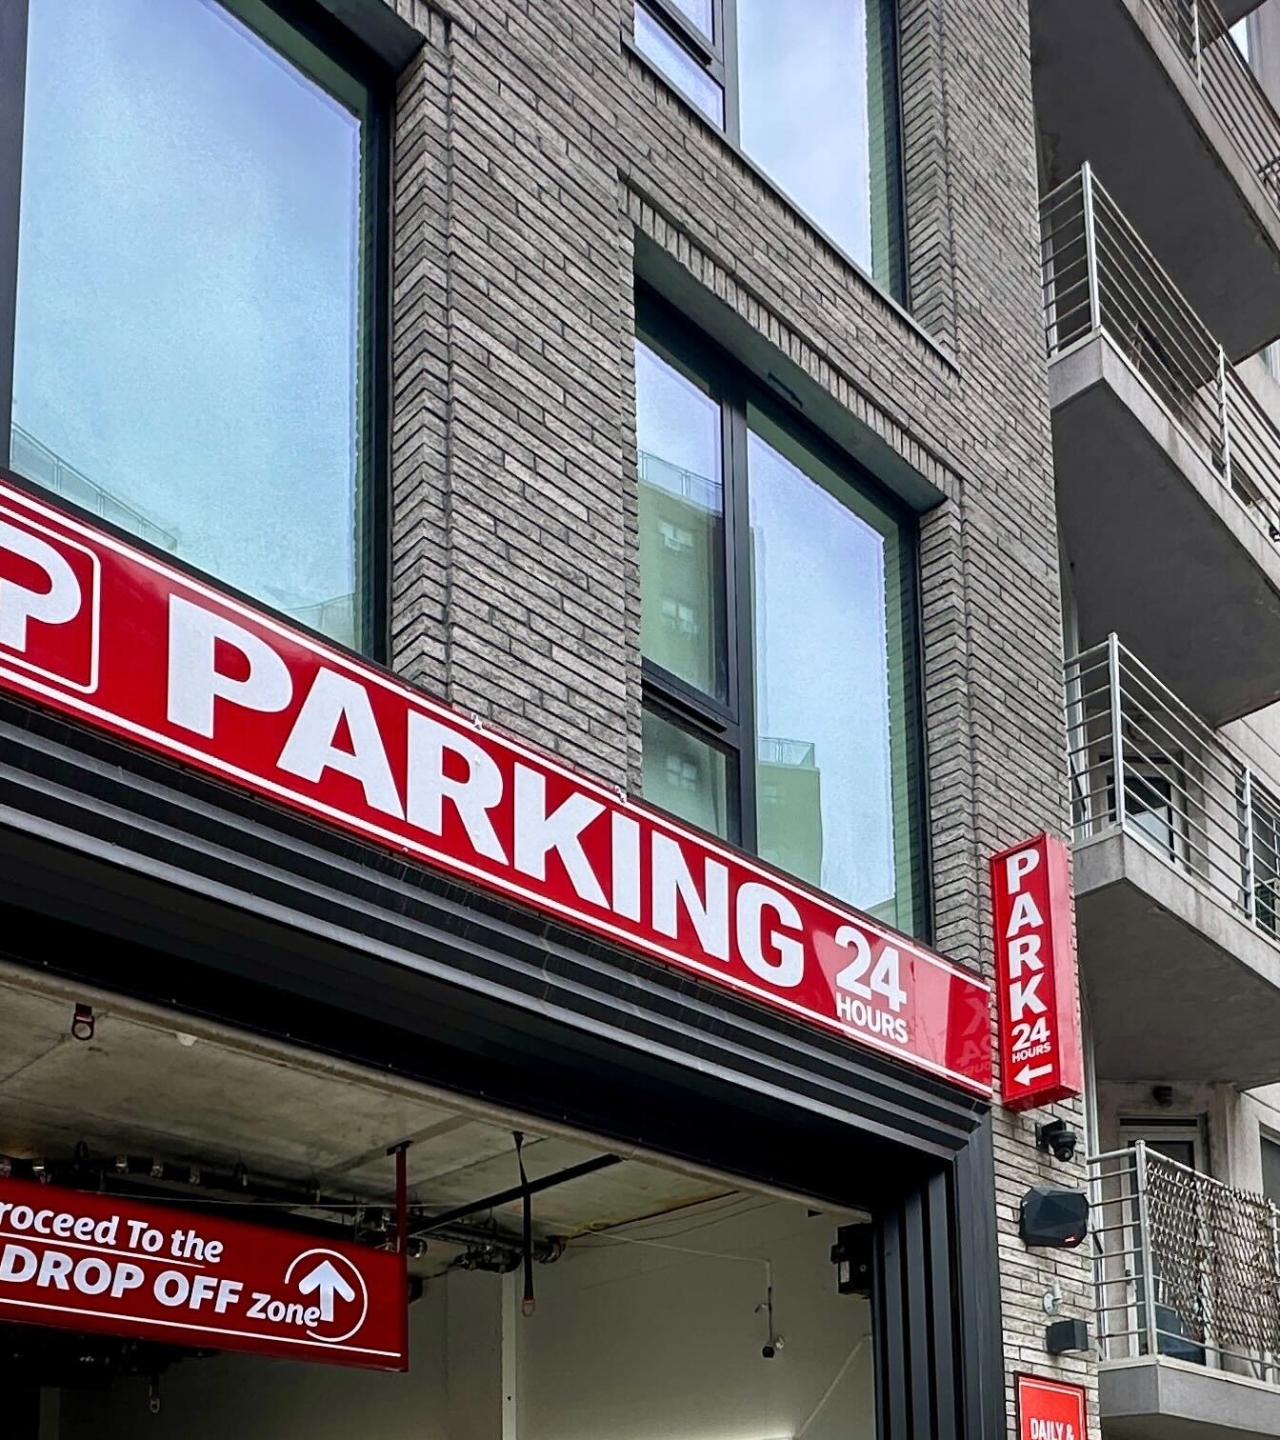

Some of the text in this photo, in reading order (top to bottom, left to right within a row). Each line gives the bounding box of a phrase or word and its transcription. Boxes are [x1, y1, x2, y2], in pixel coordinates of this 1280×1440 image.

[167, 593, 805, 988] PARKING
[1006, 848, 1048, 1022] PARK
[834, 925, 908, 1012] 24
[836, 992, 908, 1044] HOURS
[1011, 1018, 1051, 1052] 24
[1011, 1042, 1052, 1063] HOURS
[126, 1219, 164, 1253] To
[170, 1229, 224, 1263] the
[153, 1270, 244, 1314] OFF
